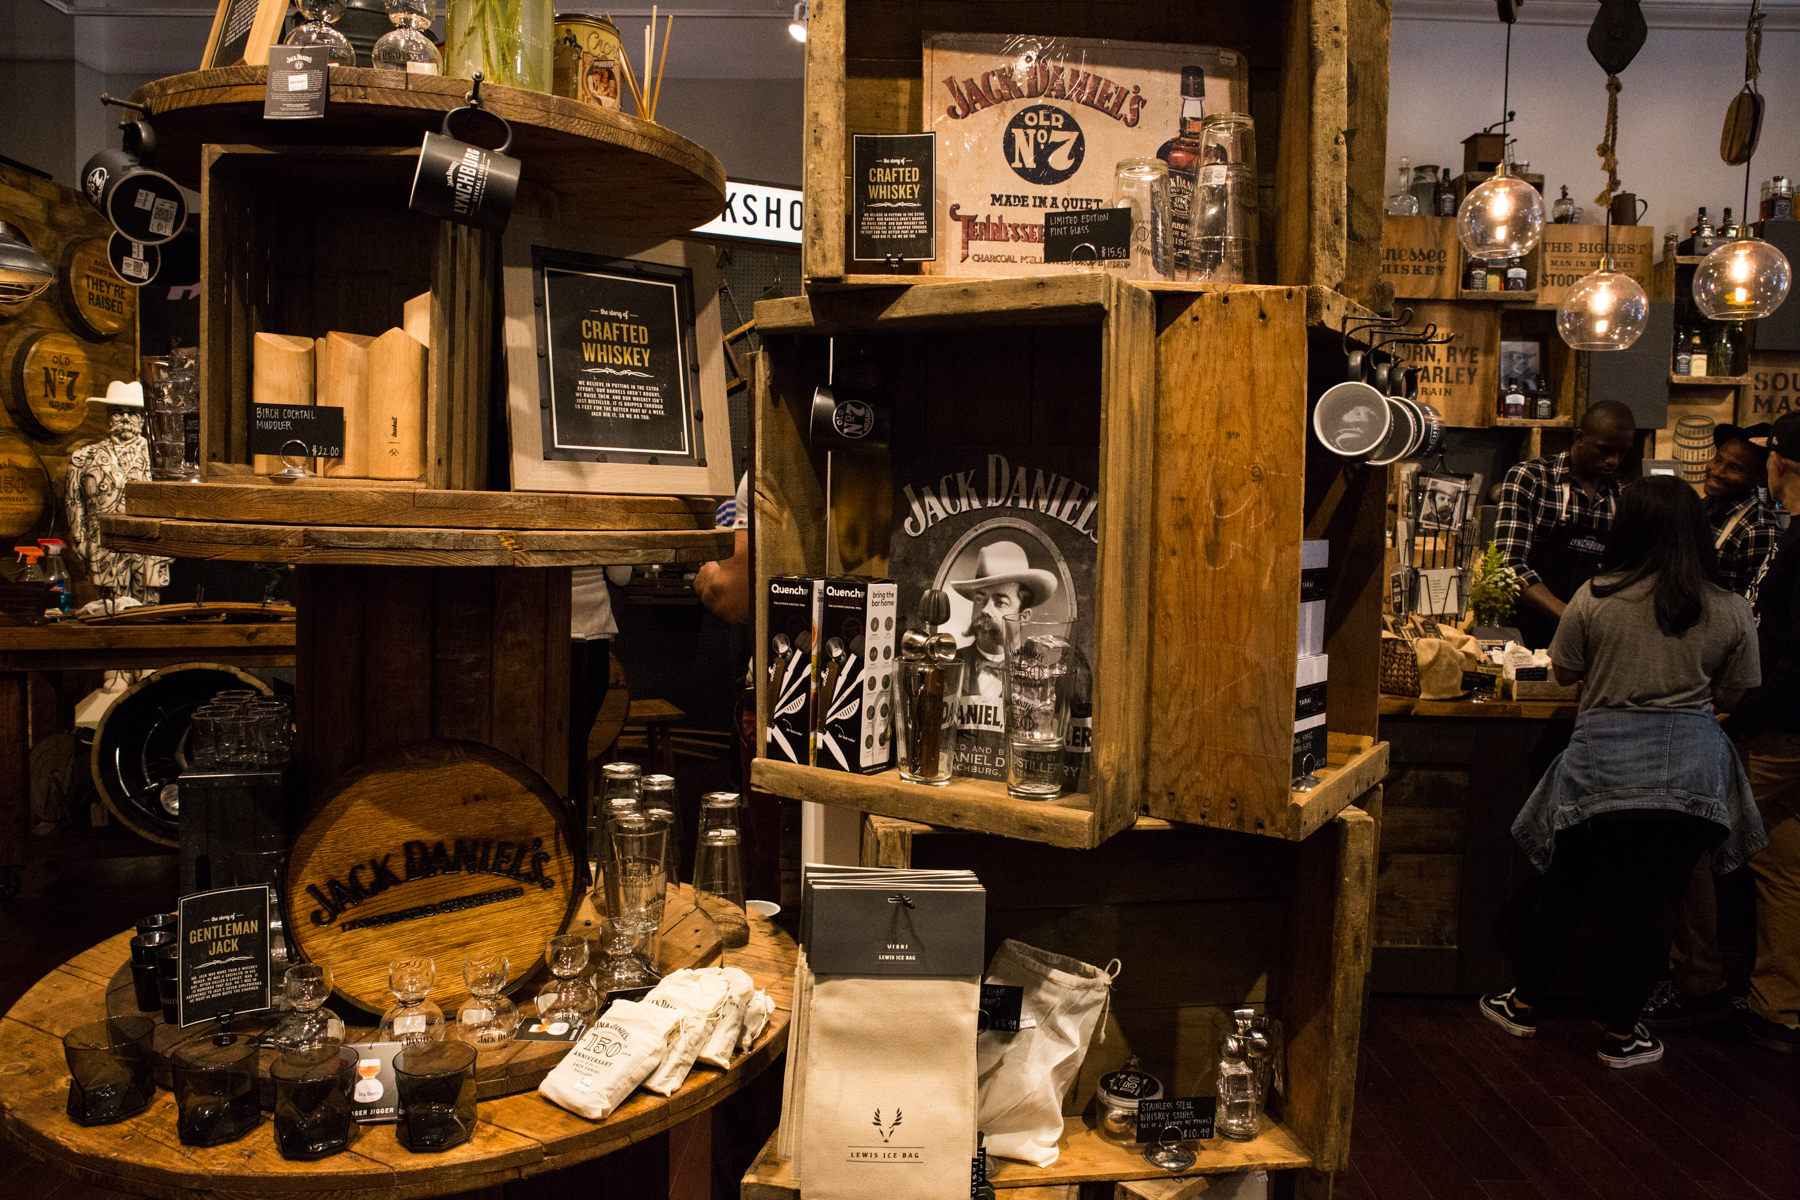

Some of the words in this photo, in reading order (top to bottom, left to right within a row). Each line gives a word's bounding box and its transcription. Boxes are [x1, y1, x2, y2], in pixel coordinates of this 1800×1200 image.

[942, 64, 1025, 120] JACK
[1026, 55, 1148, 128] DANIEL'S
[1024, 110, 1064, 128] OLD
[454, 147, 480, 215] LYNCHBURG
[869, 167, 920, 183] CRAFTED
[868, 184, 920, 200] WHISKEY
[991, 194, 1029, 207] MADE
[1032, 196, 1050, 208] IN
[1050, 197, 1060, 209] A
[1062, 198, 1103, 211] QUIET
[1050, 217, 1078, 226] LIMITED
[1081, 212, 1109, 224] EDITION
[1050, 226, 1067, 237] PINT
[1070, 225, 1090, 235] GLASS
[1383, 248, 1447, 262] nessee
[1542, 242, 1573, 254] THE
[1578, 242, 1646, 255] BIGGEST
[972, 253, 1018, 264] CHARCOAL
[1551, 259, 1572, 268] MAN
[1381, 264, 1447, 276] HISKEY
[85, 273, 128, 300] THEY'RE
[88, 291, 124, 314] RAISED
[609, 309, 622, 320] story
[582, 319, 649, 345] CRAFTED
[52, 355, 71, 366] OLD
[581, 341, 651, 368] WHISKEY
[1446, 346, 1480, 364] RYE
[1412, 365, 1478, 385] ARLEY
[1421, 387, 1453, 397] RAIN
[49, 401, 76, 412] BRAND
[256, 407, 280, 419] BIRCH
[282, 409, 317, 421] COCKTAIL
[836, 409, 844, 426] OLD
[863, 408, 873, 433] BRAND
[256, 420, 293, 431] MUDDLER
[902, 468, 983, 538] JACK
[771, 583, 804, 596] Quench
[826, 586, 860, 599] Quench
[872, 591, 886, 600] bring
[886, 591, 895, 599] the
[880, 600, 895, 608] home
[972, 745, 992, 755] AND
[952, 753, 992, 768] ANIEL
[305, 853, 403, 927] JACK
[402, 837, 551, 886] DANIEL'S
[189, 919, 259, 944] GENTLEMAN
[208, 937, 240, 956] JACK
[477, 1035, 496, 1044] JACK
[583, 1033, 623, 1058] 150
[573, 1050, 614, 1068] ANNIVERSARY
[369, 1107, 395, 1116] JIGGER
[1141, 1101, 1173, 1112] STAINLESS
[1176, 1101, 1195, 1110] STEEL
[1140, 1113, 1170, 1122] WHISKEY
[1173, 1110, 1195, 1119] STONES
[1183, 1128, 1211, 1139] $10.99
[850, 1151, 879, 1159] LEWIS
[971, 1161, 979, 1195] VISKI
